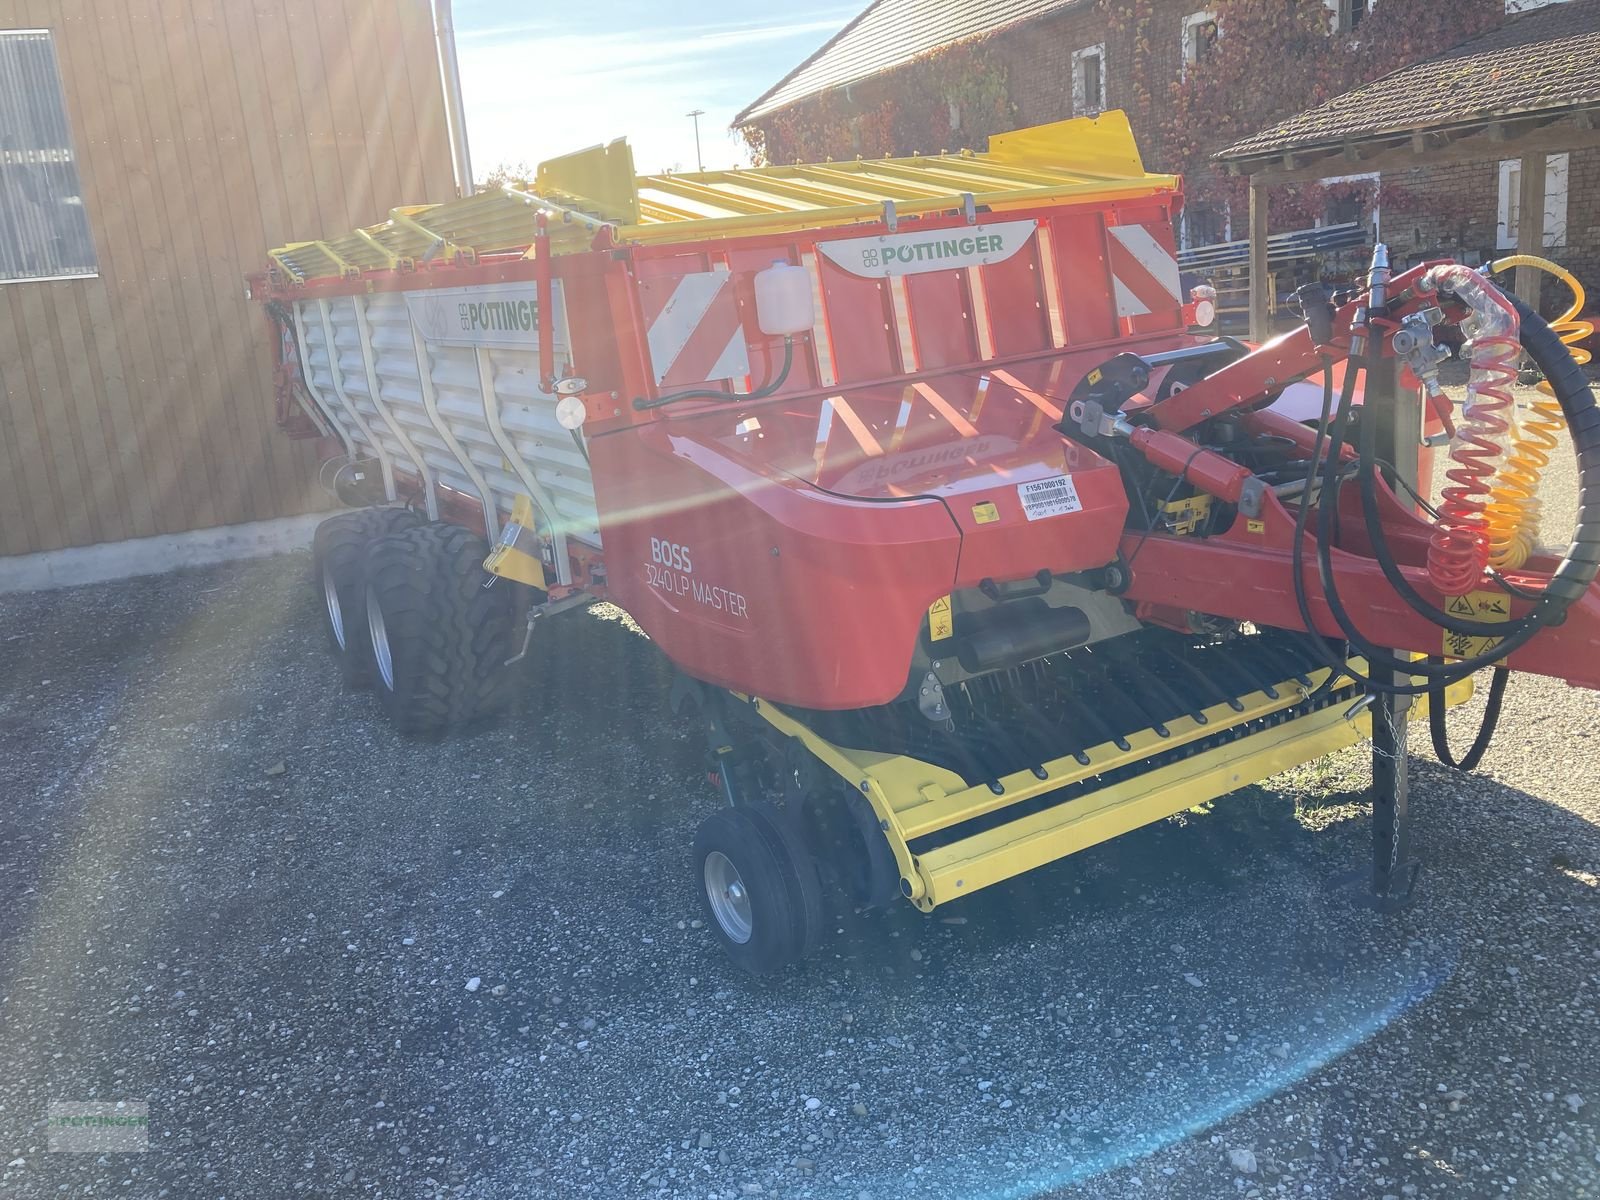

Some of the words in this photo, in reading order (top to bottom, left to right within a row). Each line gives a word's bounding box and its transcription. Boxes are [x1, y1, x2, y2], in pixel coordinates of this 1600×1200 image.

[881, 235, 1003, 265] PÖTTINGER
[469, 301, 539, 331] PÖTTINGE
[1026, 479, 1067, 492] F1567000192
[651, 537, 692, 573] BOSS
[644, 563, 672, 592] 3240
[674, 573, 689, 596] LP
[692, 579, 748, 619] MASTER
